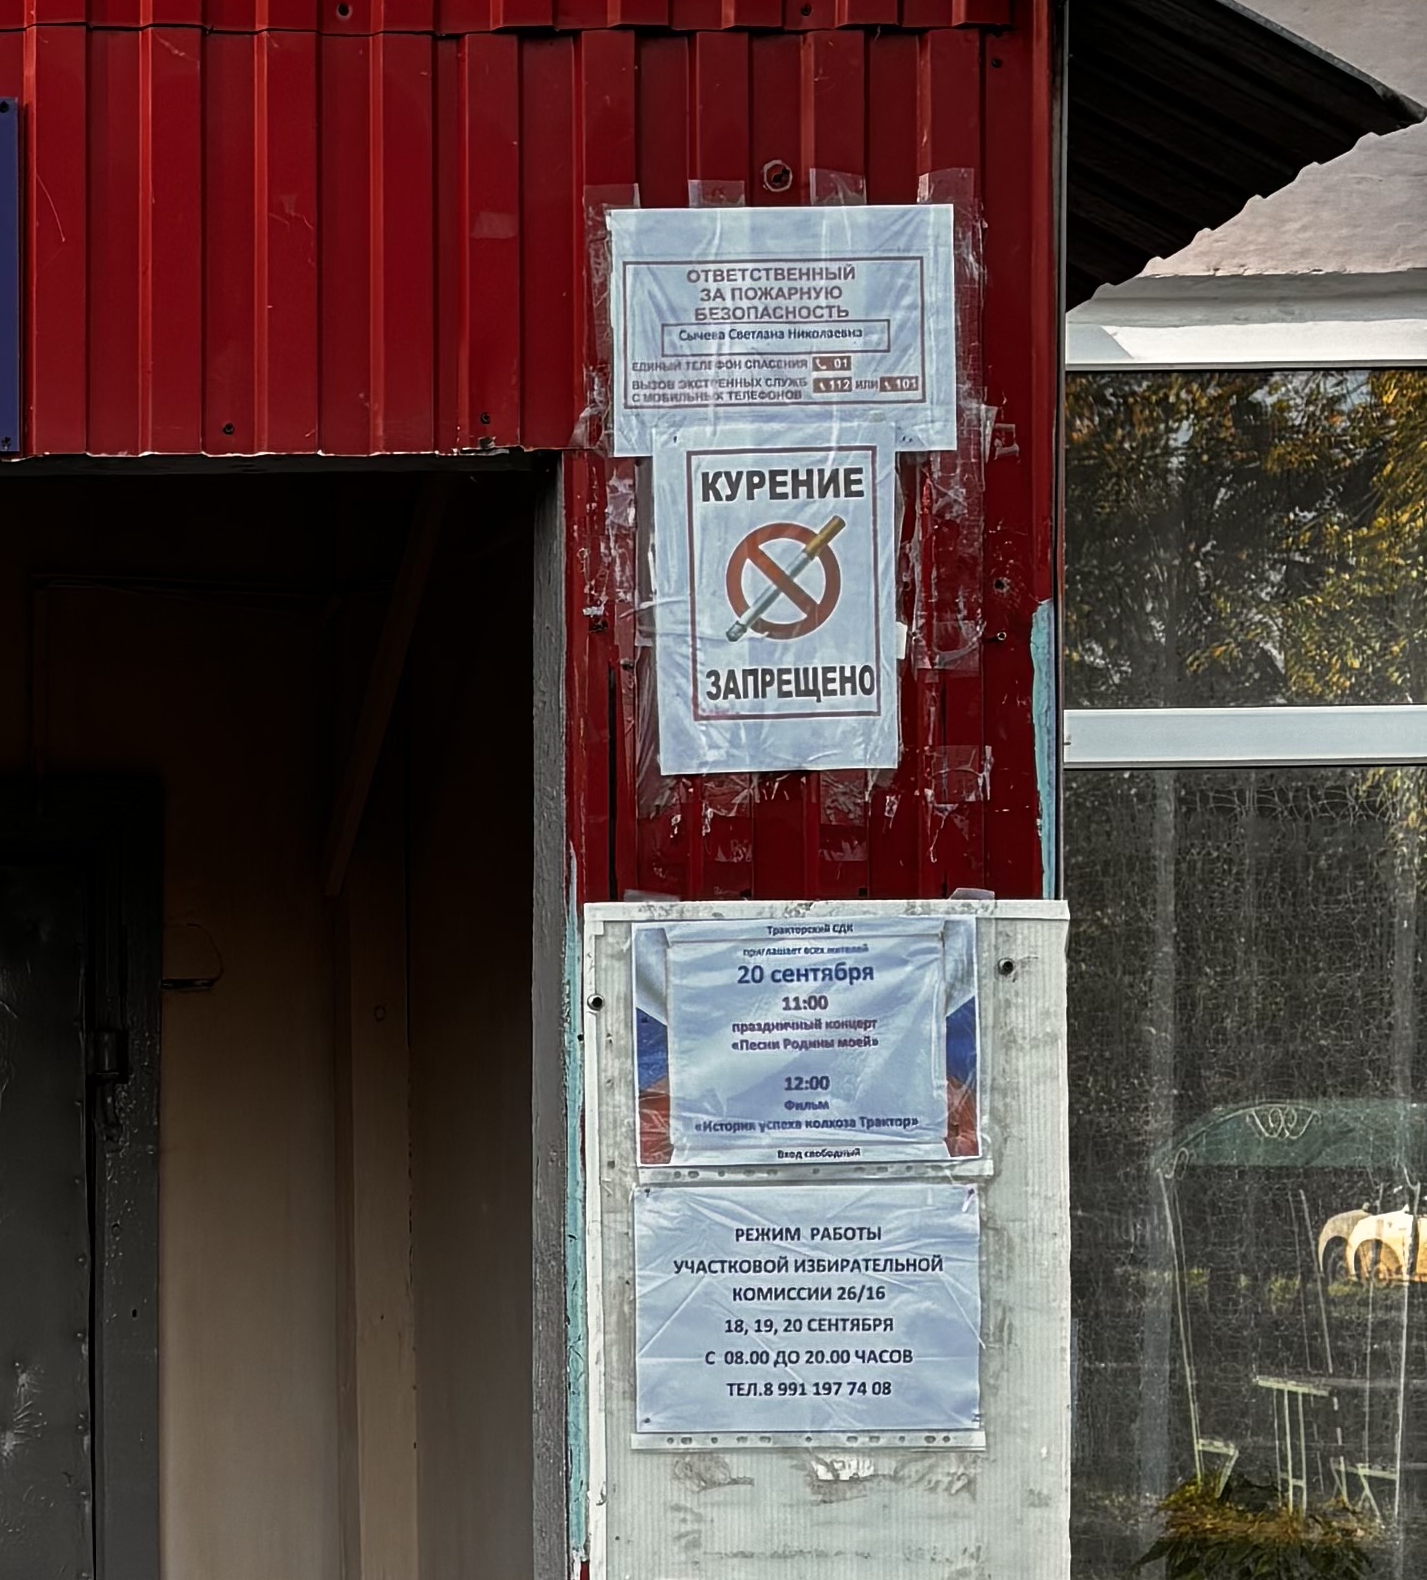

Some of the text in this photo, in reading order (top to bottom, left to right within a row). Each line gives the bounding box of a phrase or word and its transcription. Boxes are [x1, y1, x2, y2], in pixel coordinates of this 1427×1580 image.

[687, 264, 855, 283] ОТВЕТСТВЕННЫЙ
[700, 286, 842, 301] ЗА ПОЖАРНУЮ
[695, 305, 851, 323] БЕЗОПАСНОСТЬ
[729, 329, 784, 340] Светлана
[834, 359, 847, 367] 01
[829, 380, 850, 389] 112
[855, 381, 878, 389] ИЛИ
[895, 380, 917, 389] 101
[702, 467, 864, 502] КУРЕНИЕ
[706, 665, 874, 703] ЗАПРЕЩЕНО
[833, 924, 853, 933] СДК
[738, 962, 873, 985] 20 сентября
[782, 995, 828, 1010] 11:00
[732, 1018, 877, 1034] праздничный концерт
[732, 1036, 878, 1051] «Песни Родины моей»
[785, 1076, 829, 1090] 12:00
[784, 1100, 829, 1110] Фильм
[859, 1116, 918, 1130] Трактор»
[736, 1227, 881, 1242] РЕЖИМ РАБОТЫ
[674, 1255, 943, 1274] УЧАСТКОВОЙ ИЗБИРАТЕЛЬНОЙ
[733, 1285, 885, 1302] КОМИССИИ 26/16
[725, 1318, 893, 1335] 18, 19, 20 СЕНТЯБРЯ
[705, 1349, 912, 1367] С 08.00 ДО 20.00 ЧАСОВ
[726, 1382, 891, 1396] ТЕЛ.8 991 197 74 08
